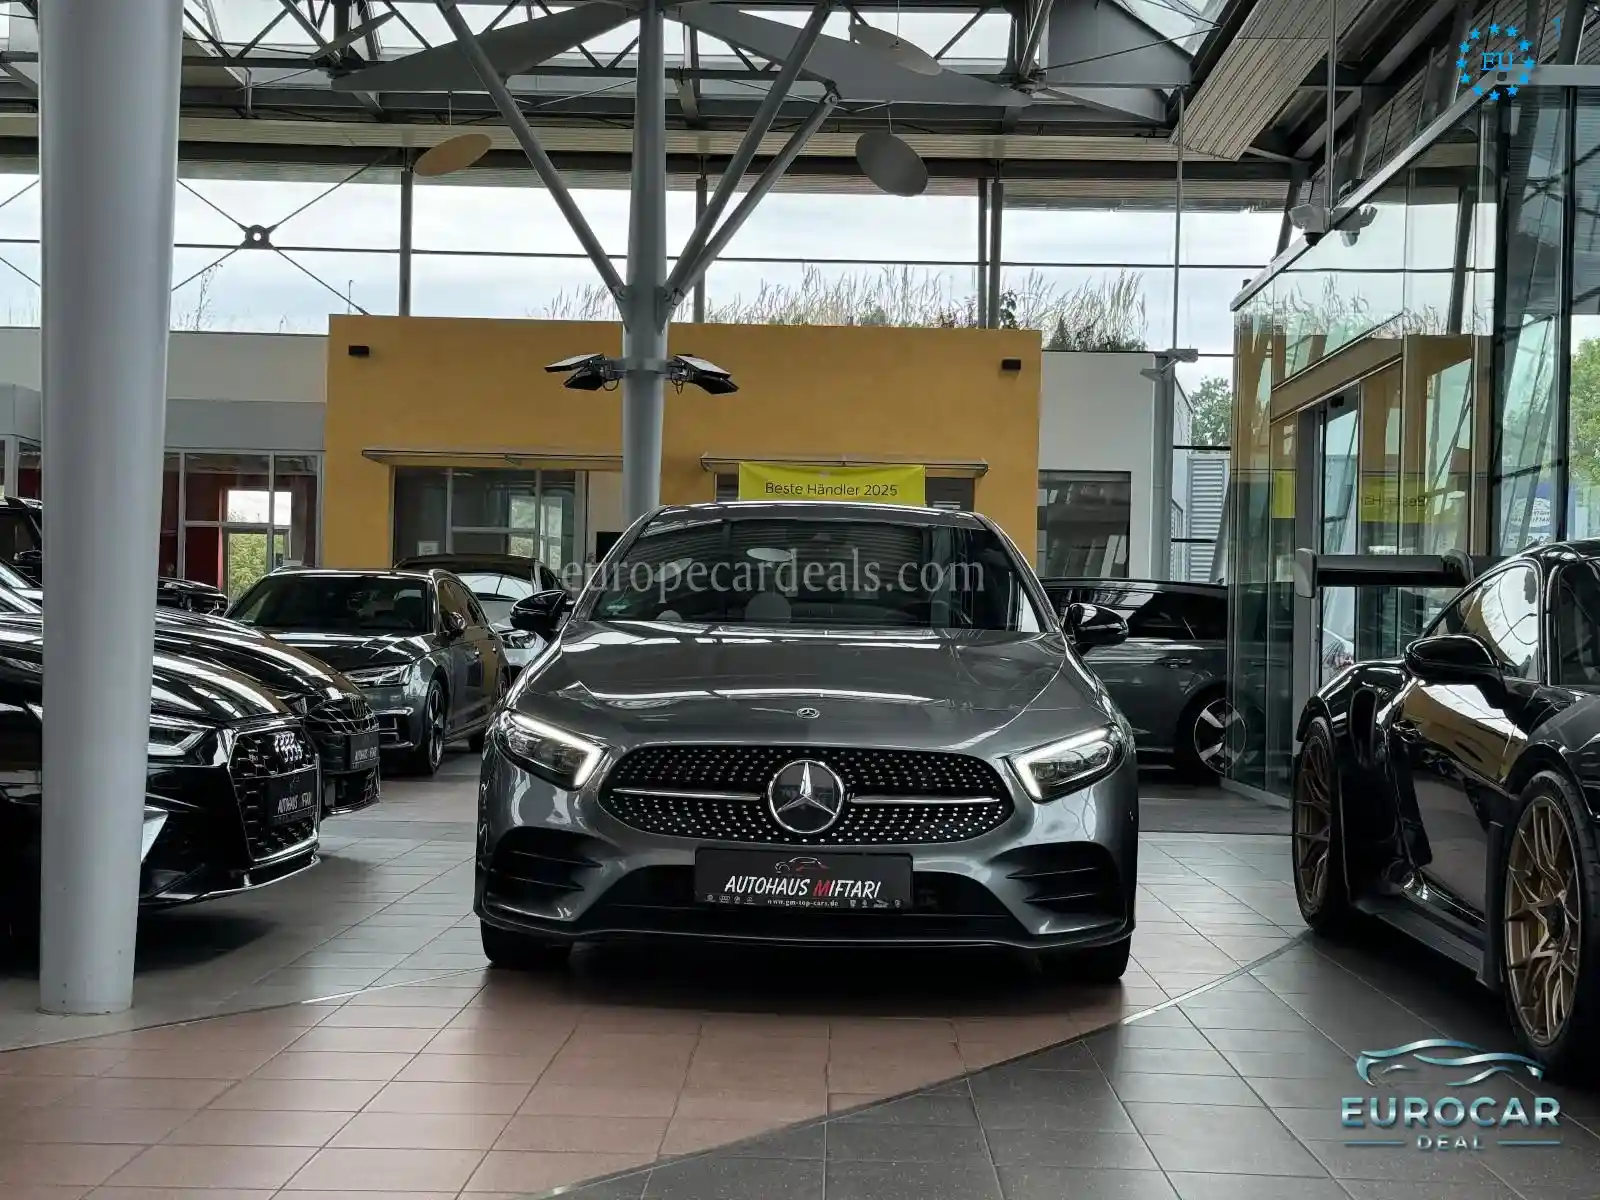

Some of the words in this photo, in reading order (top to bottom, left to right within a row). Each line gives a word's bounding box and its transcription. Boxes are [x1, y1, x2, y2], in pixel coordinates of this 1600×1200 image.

[765, 482, 803, 495] Beste
[807, 483, 860, 496] Händler
[864, 484, 898, 496] 2025
[724, 875, 811, 897] AUTOHAUS
[812, 879, 882, 899] MIFTARI
